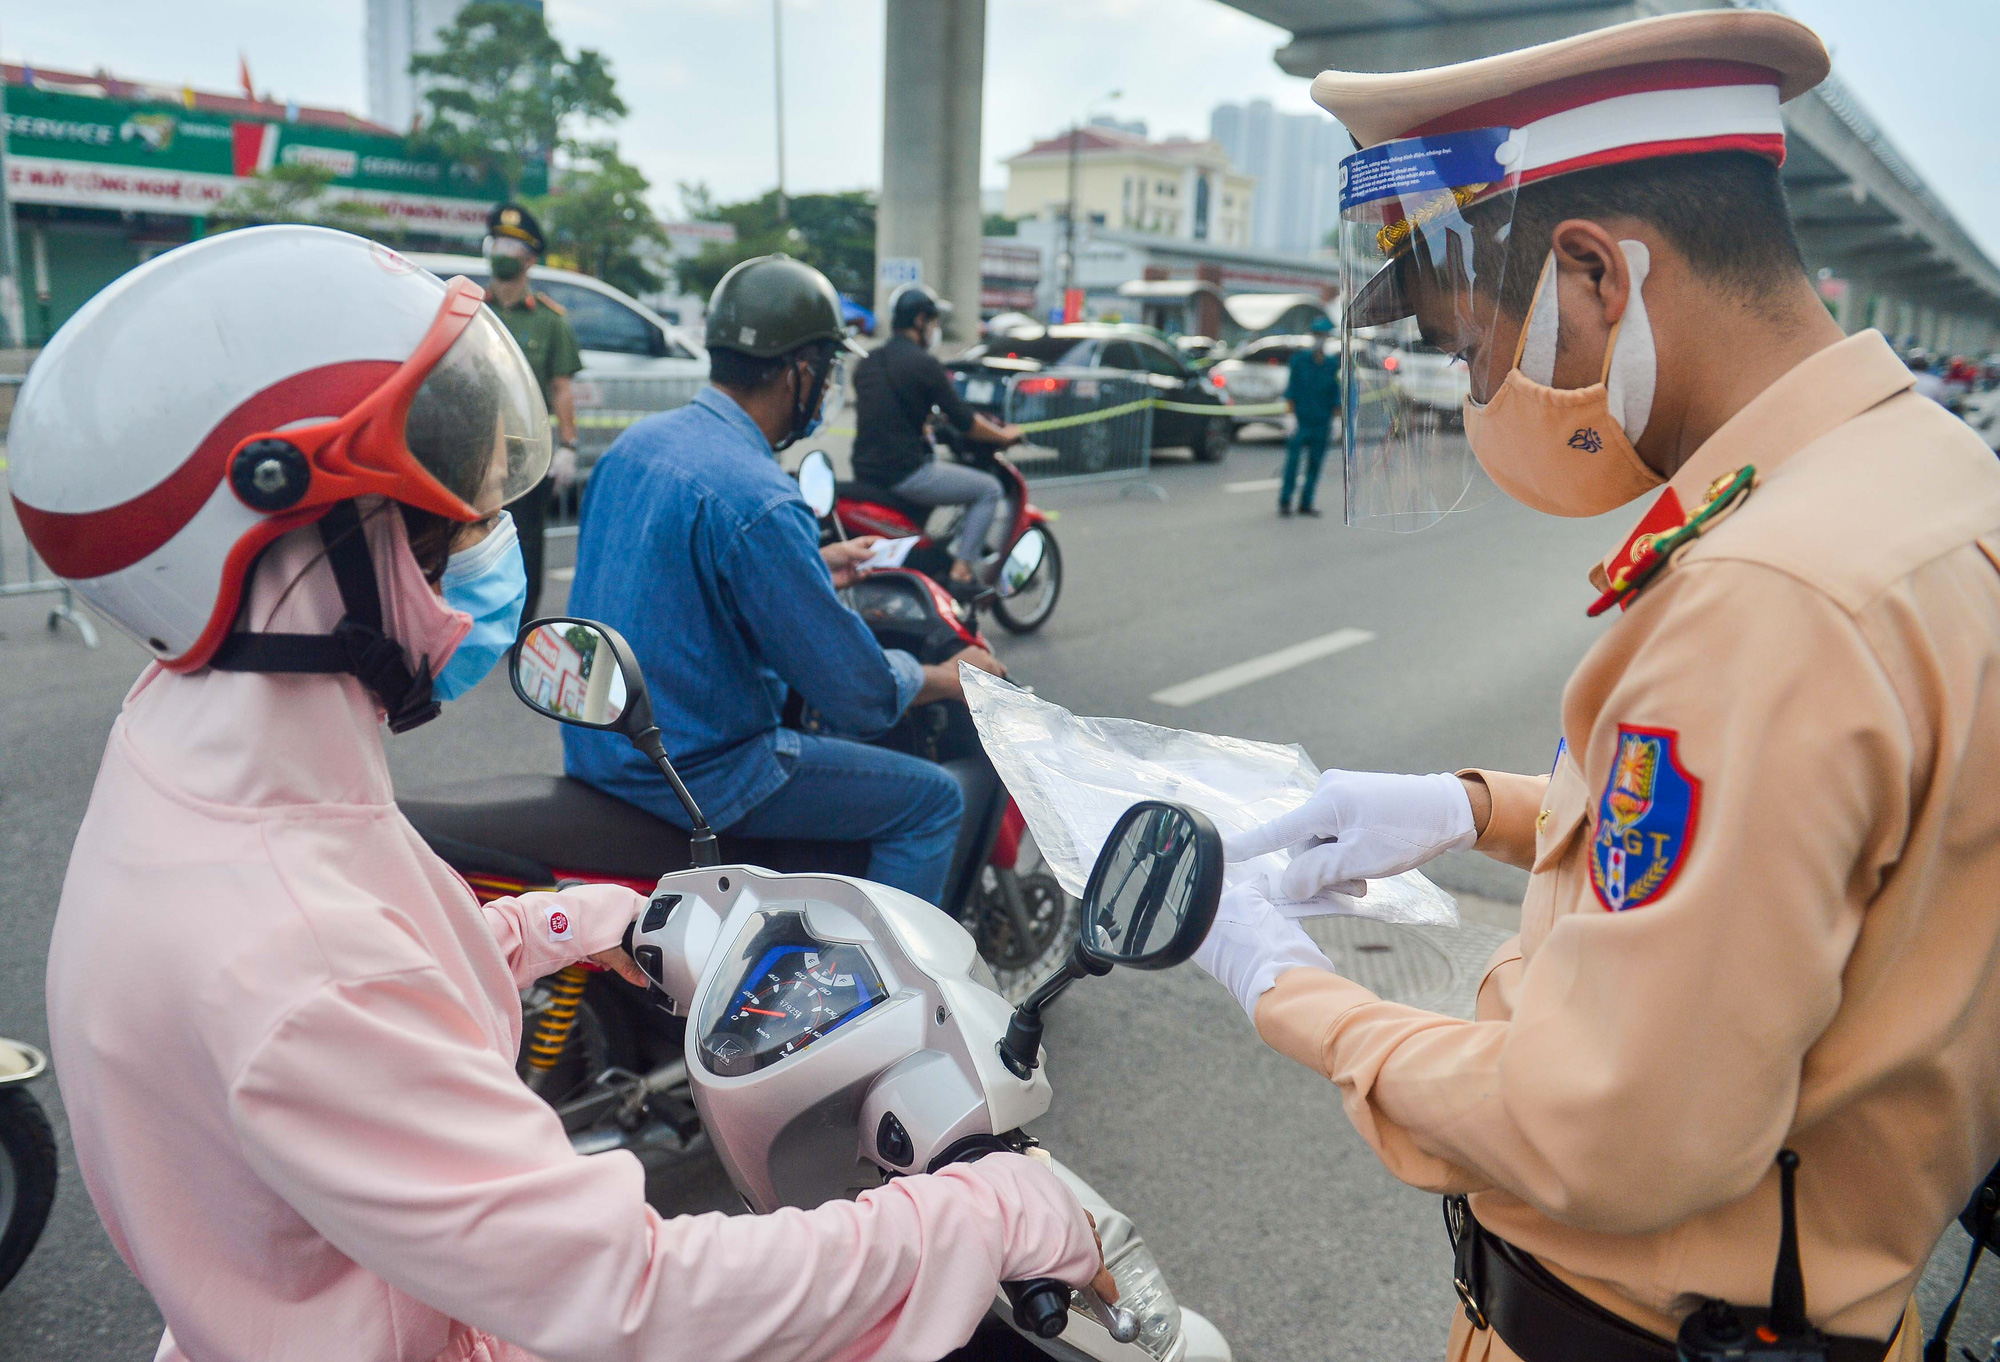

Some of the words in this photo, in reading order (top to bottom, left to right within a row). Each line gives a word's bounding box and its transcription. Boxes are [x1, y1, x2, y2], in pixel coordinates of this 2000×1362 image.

[768, 973, 780, 982] 40
[794, 971, 807, 980] 60
[742, 990, 755, 999] 20
[818, 987, 832, 996] 80
